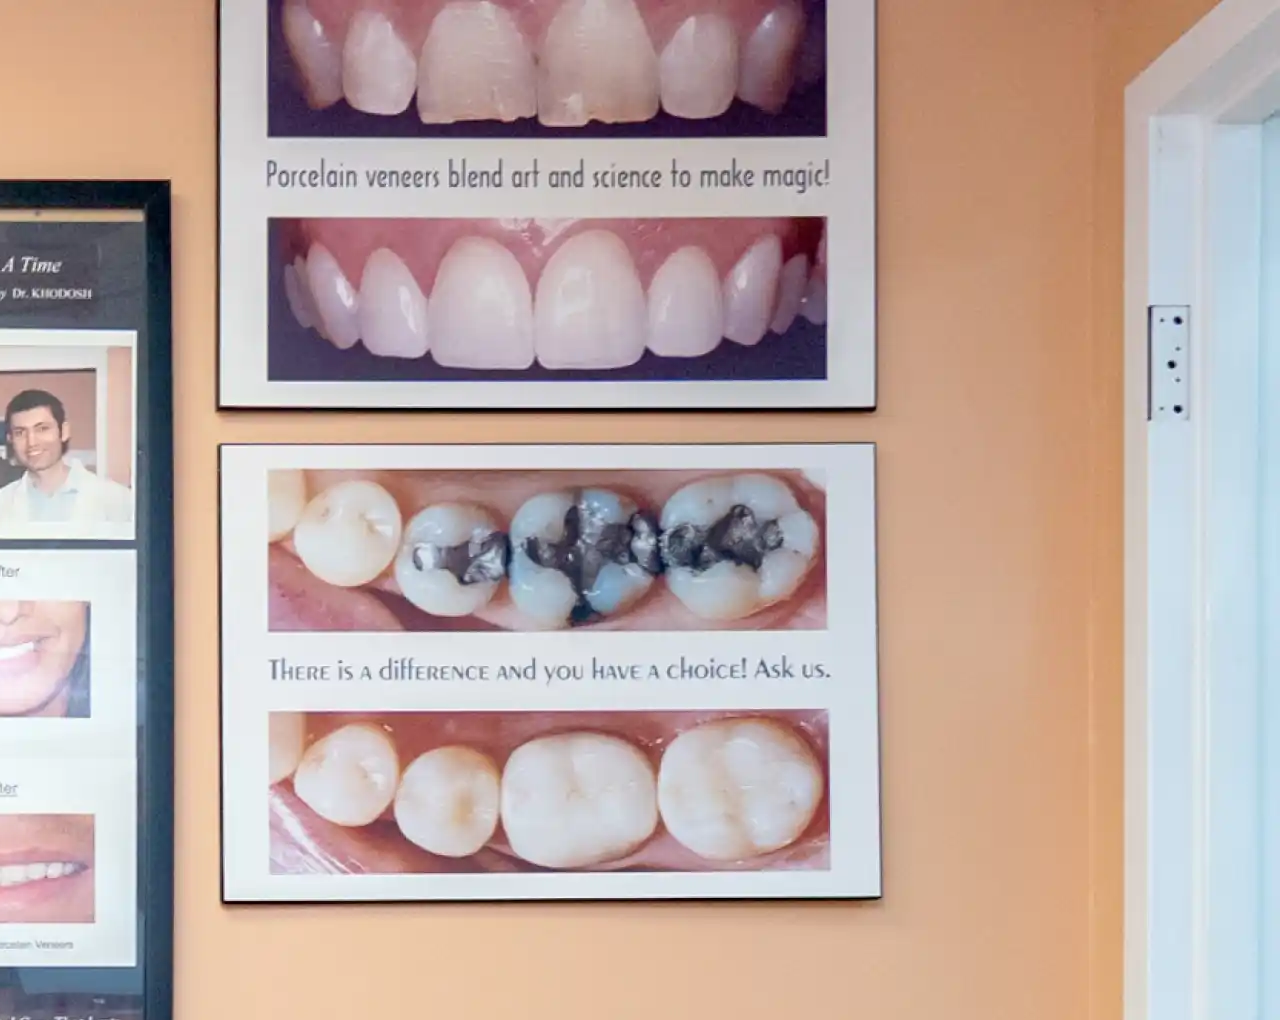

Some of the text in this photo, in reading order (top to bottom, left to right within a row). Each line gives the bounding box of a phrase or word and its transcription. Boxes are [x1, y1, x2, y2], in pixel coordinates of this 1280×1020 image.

[265, 158, 831, 194] Porcelain veneers blend art and science to make magic!
[1, 255, 16, 273] A
[20, 256, 63, 273] Time
[12, 288, 29, 299] Dr.
[32, 288, 93, 300] KHODOSH
[338, 659, 354, 681] is
[543, 663, 584, 686] you
[753, 655, 795, 680] Ask
[801, 661, 831, 679] us.
